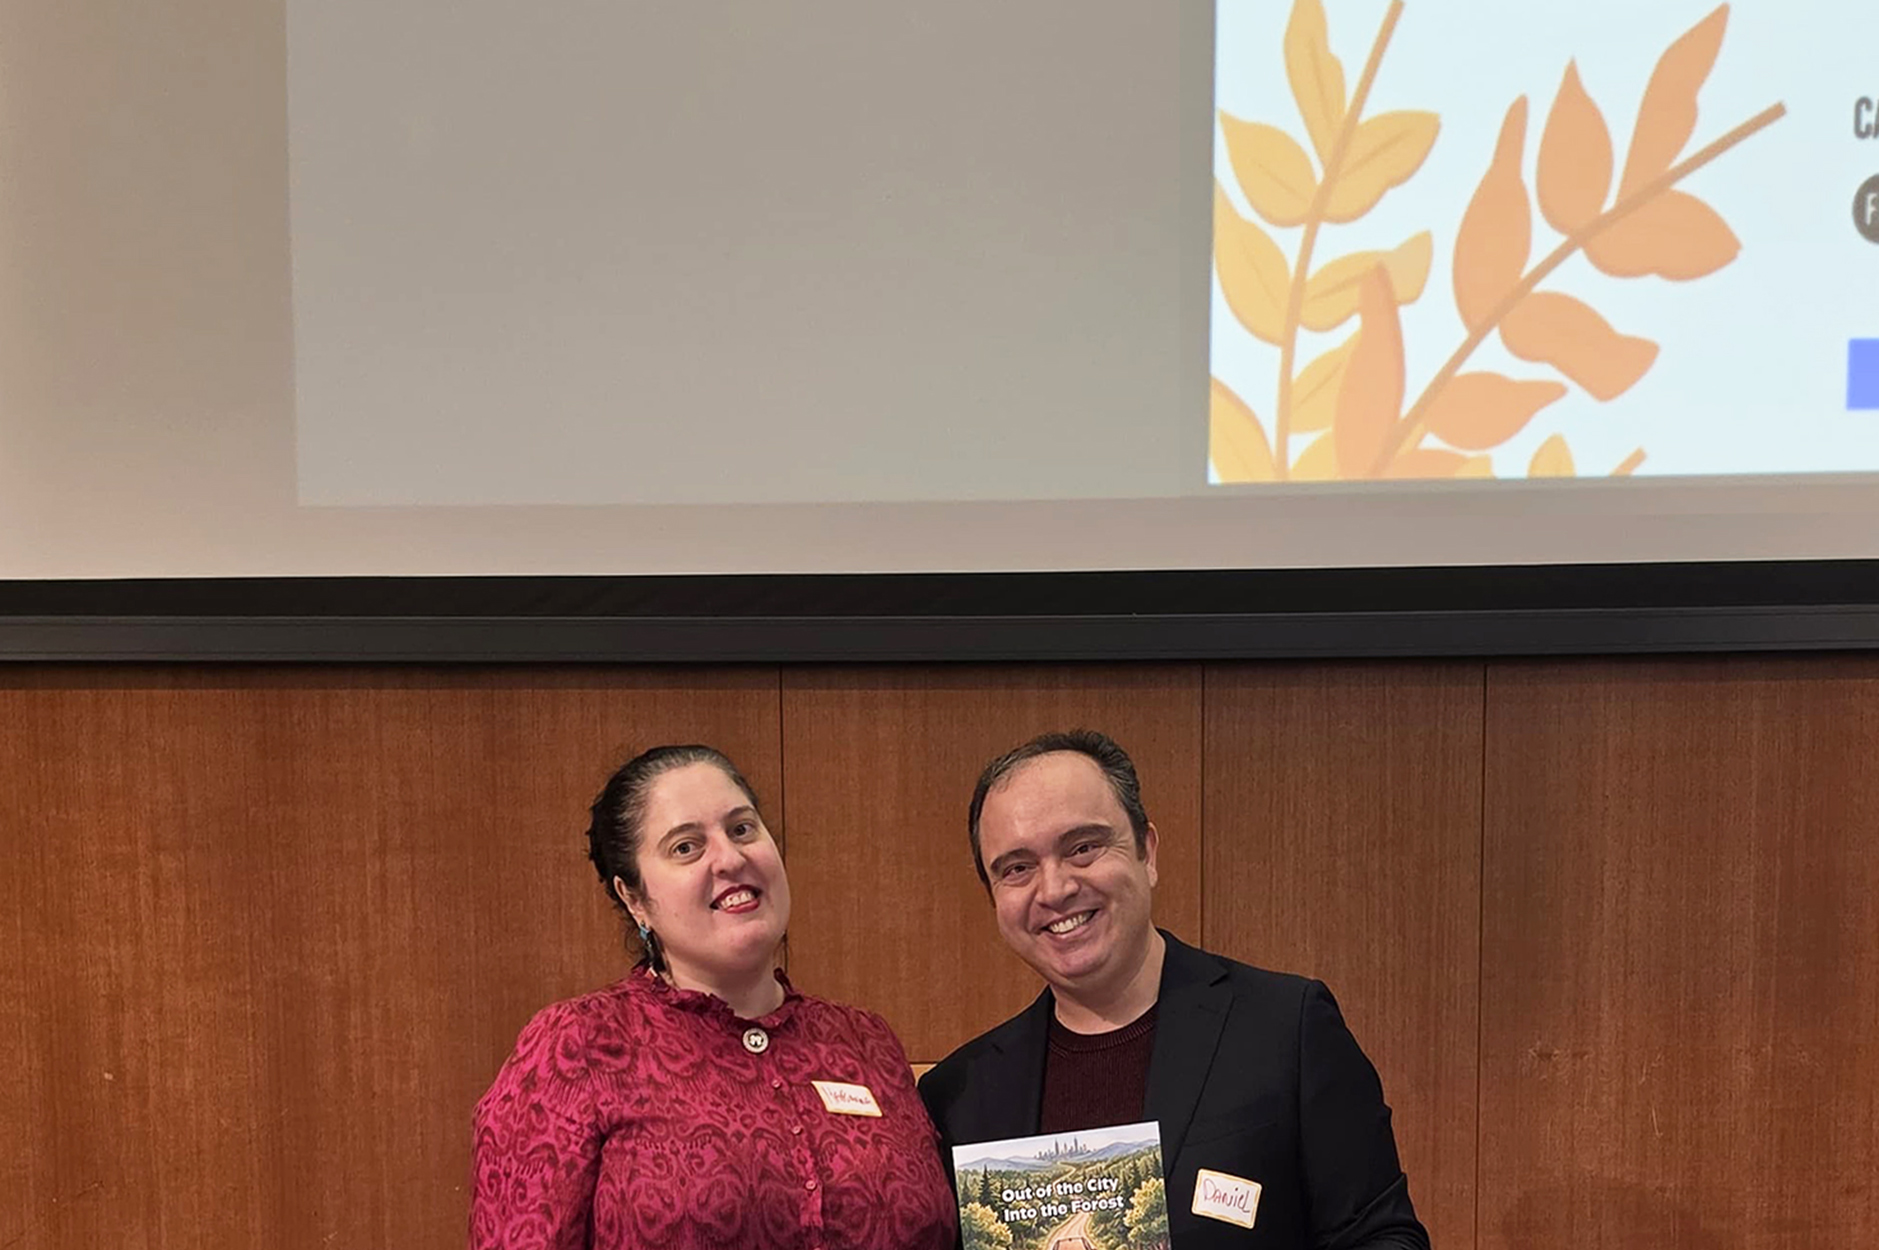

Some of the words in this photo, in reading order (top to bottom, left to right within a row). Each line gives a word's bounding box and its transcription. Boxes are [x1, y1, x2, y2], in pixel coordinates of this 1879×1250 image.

[1002, 1187, 1032, 1202] Out
[1036, 1183, 1052, 1198] of
[1056, 1182, 1083, 1195] the
[1087, 1177, 1118, 1192] City
[1004, 1208, 1037, 1222] Into
[1041, 1203, 1067, 1217] the
[1071, 1195, 1124, 1213] Forest
